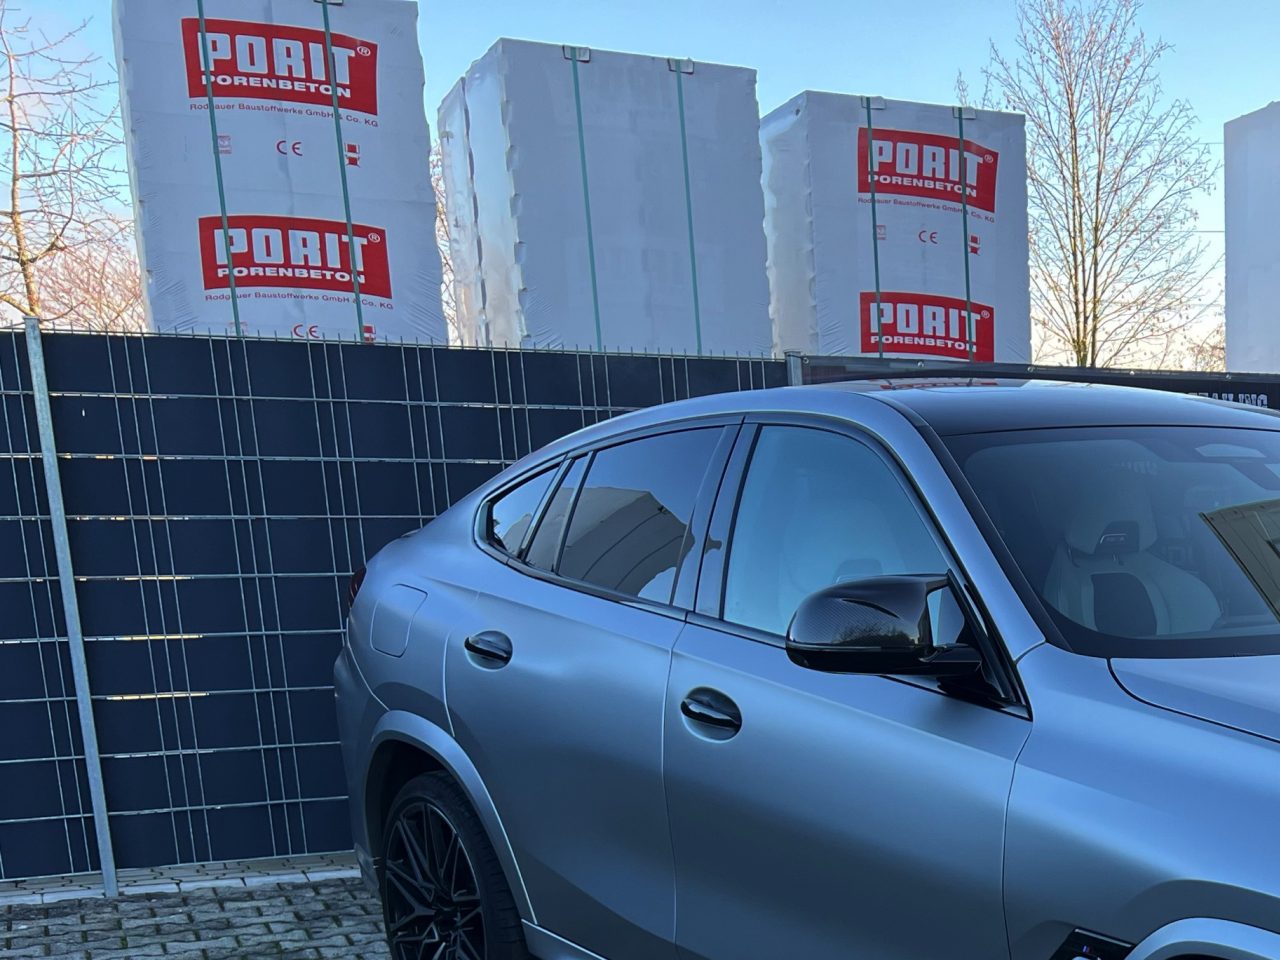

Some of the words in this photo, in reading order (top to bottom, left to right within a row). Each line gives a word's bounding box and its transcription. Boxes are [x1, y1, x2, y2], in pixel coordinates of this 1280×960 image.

[201, 75, 351, 98] PORENBETON
[190, 103, 235, 111] Rodauer
[238, 103, 303, 115] Baustoffwerke
[364, 118, 379, 127] KG
[868, 174, 977, 198] PORENBETON
[217, 267, 366, 284] PORENBETON
[205, 293, 251, 301] Rodguer
[254, 292, 319, 301] Baustoffwerke
[870, 335, 977, 353] PORENBETON
